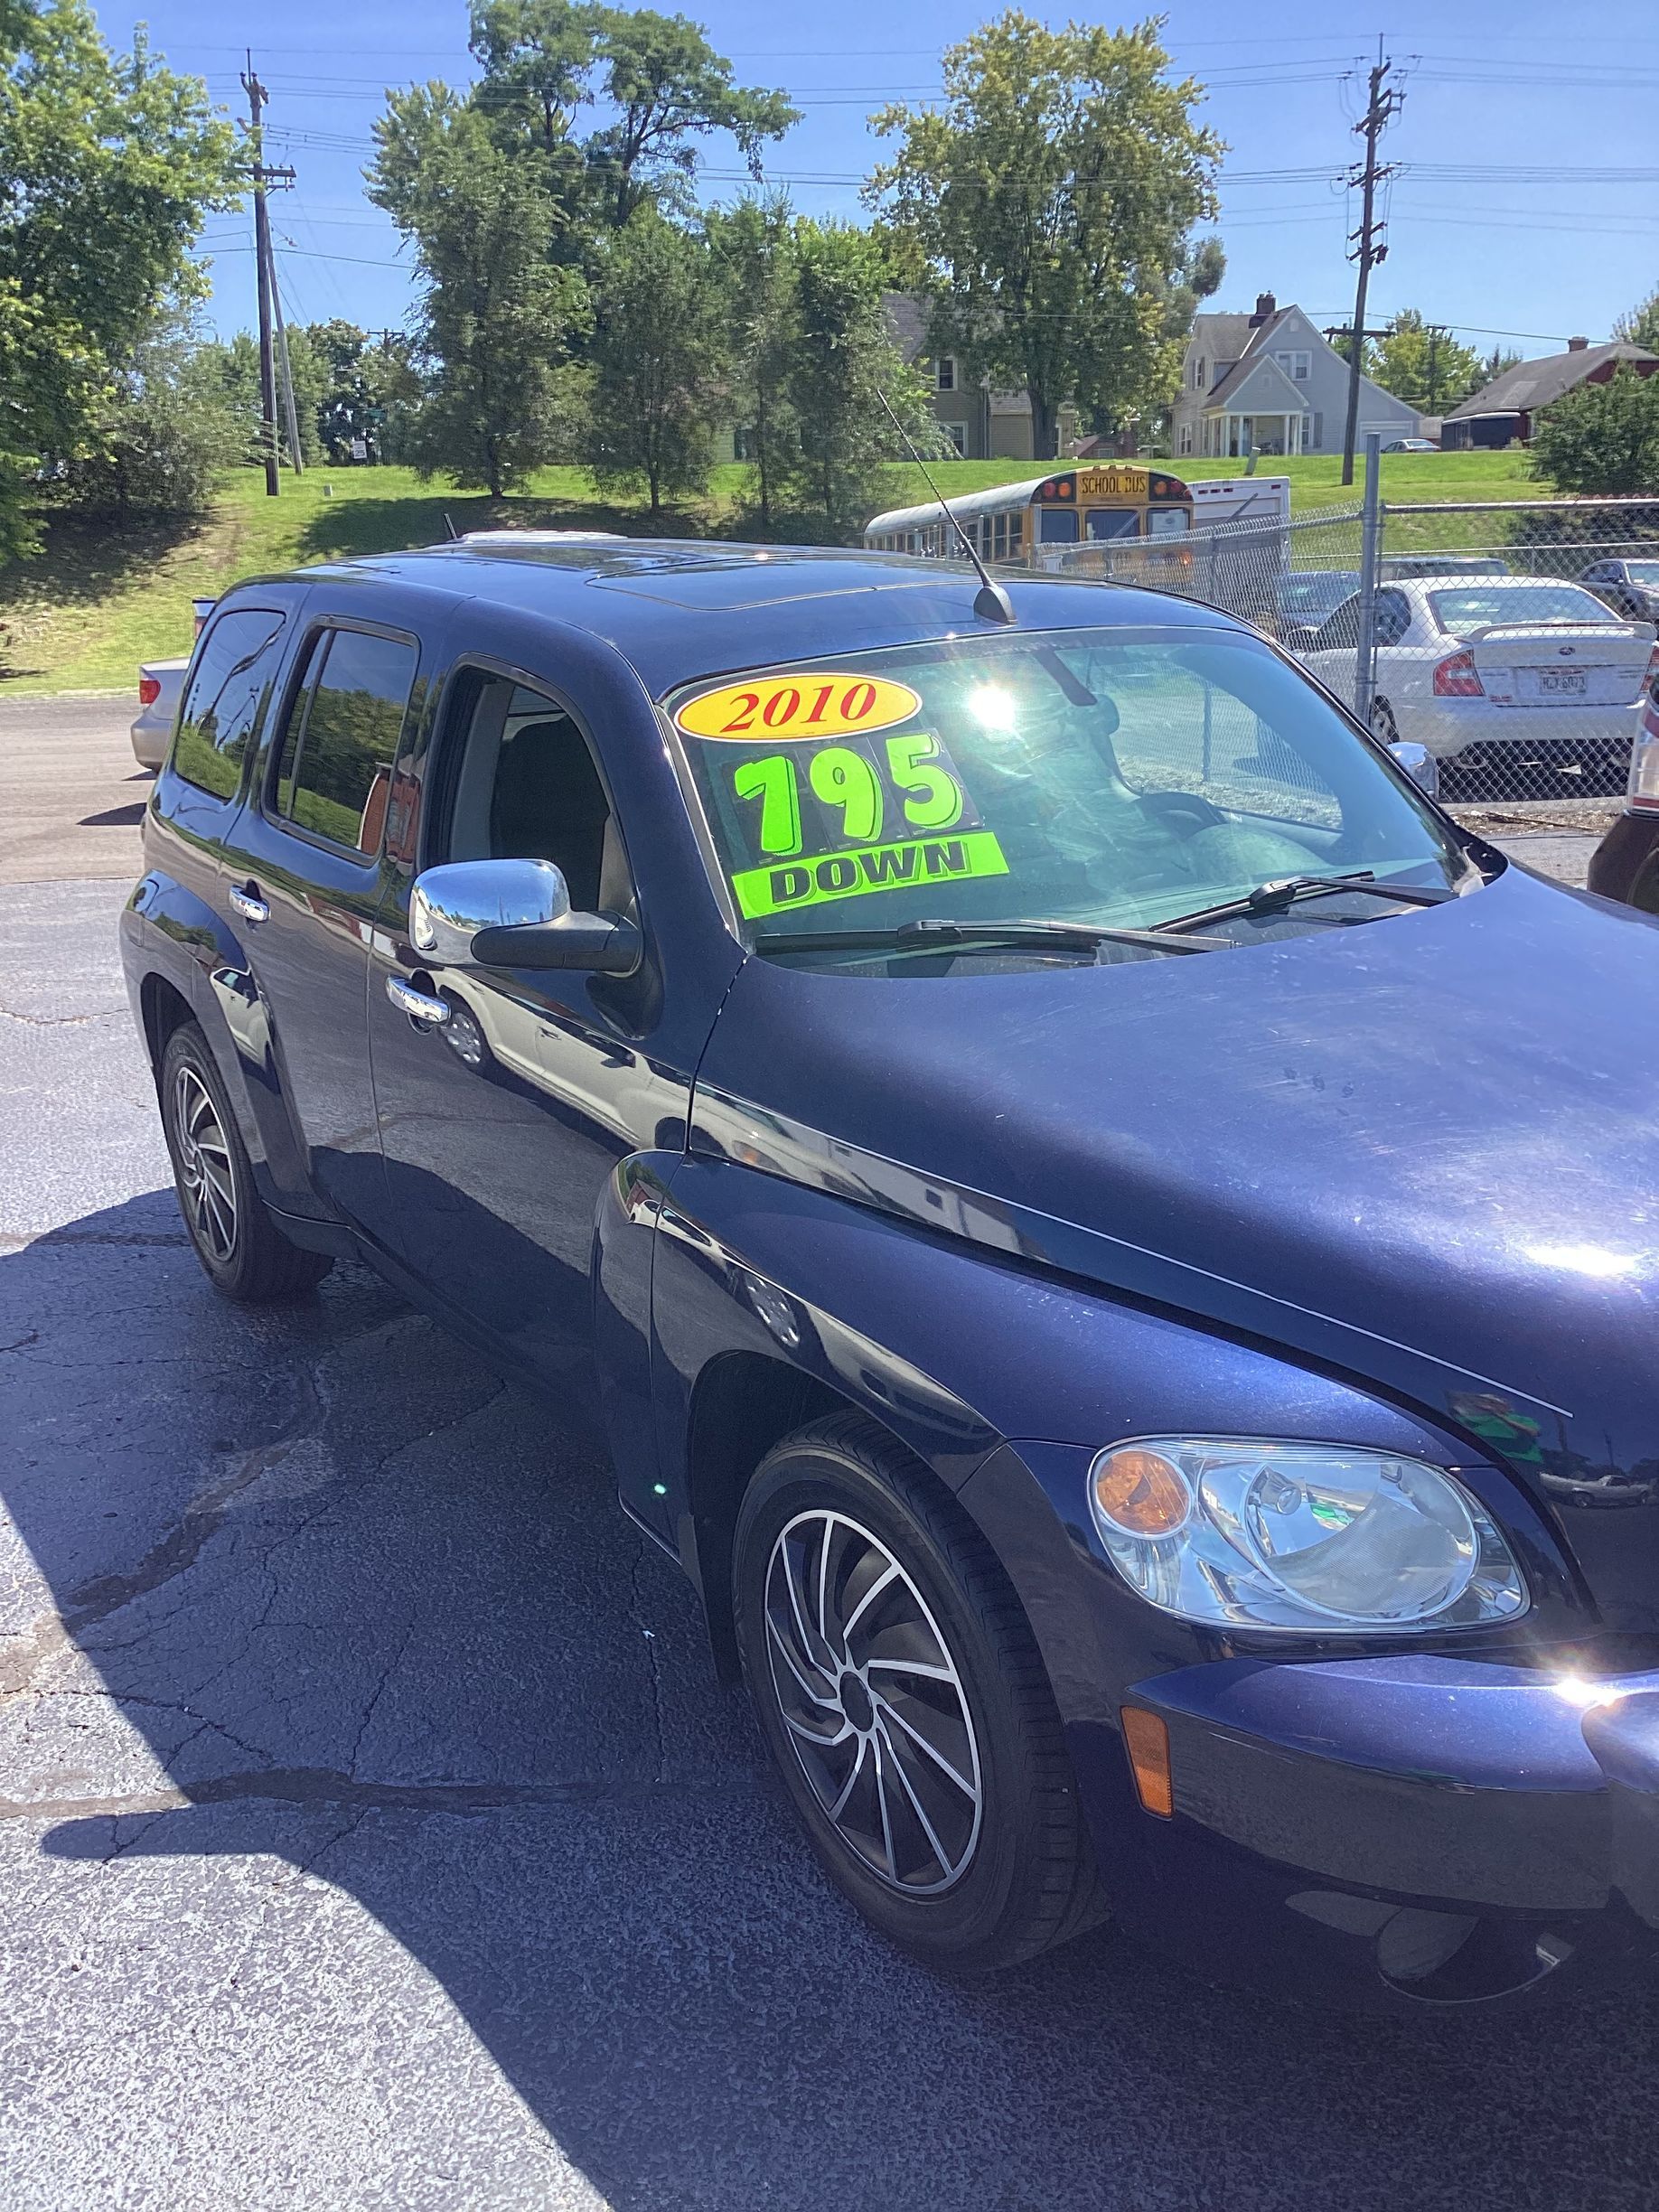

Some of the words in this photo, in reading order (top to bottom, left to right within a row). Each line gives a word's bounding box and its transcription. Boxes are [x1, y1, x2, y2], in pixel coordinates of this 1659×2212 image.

[1082, 476, 1122, 493] SCHOOL
[1125, 476, 1146, 493] BUS
[719, 683, 877, 733] 2010
[770, 841, 970, 906] DOWN
